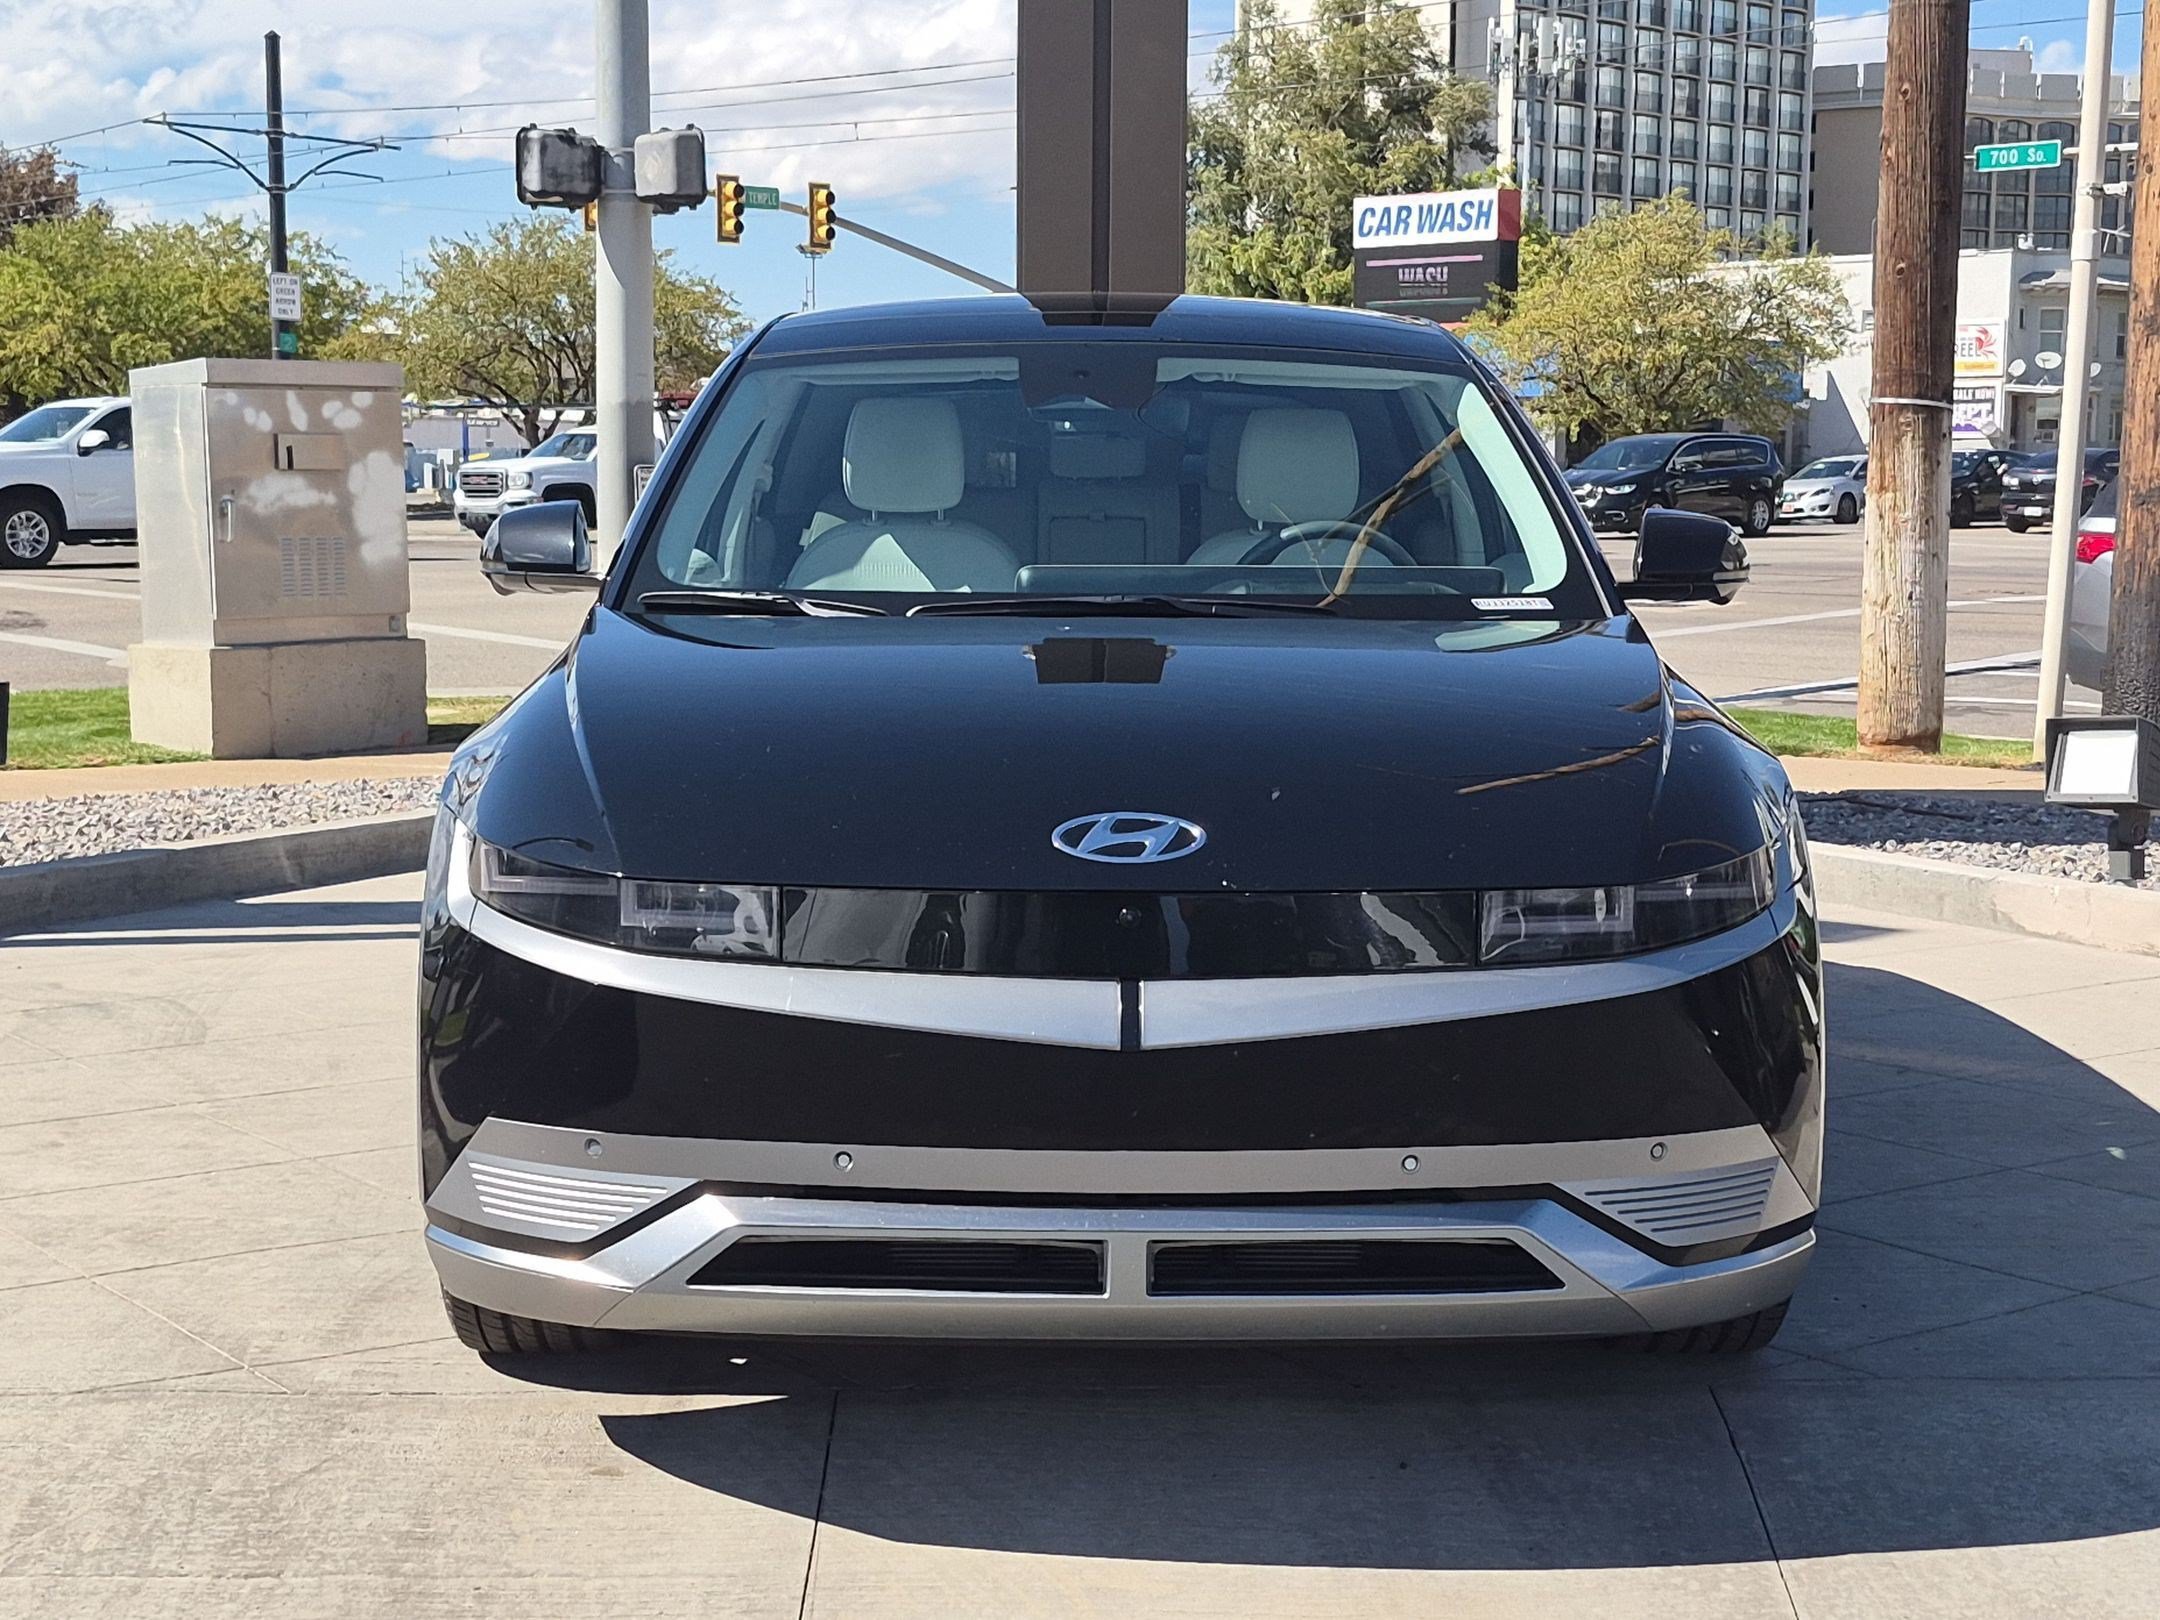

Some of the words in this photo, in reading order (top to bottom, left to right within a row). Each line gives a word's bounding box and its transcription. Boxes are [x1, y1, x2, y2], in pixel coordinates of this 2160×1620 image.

[1989, 148, 2018, 165] 700
[1358, 206, 1412, 238] CAR
[1417, 199, 1494, 234] WASH
